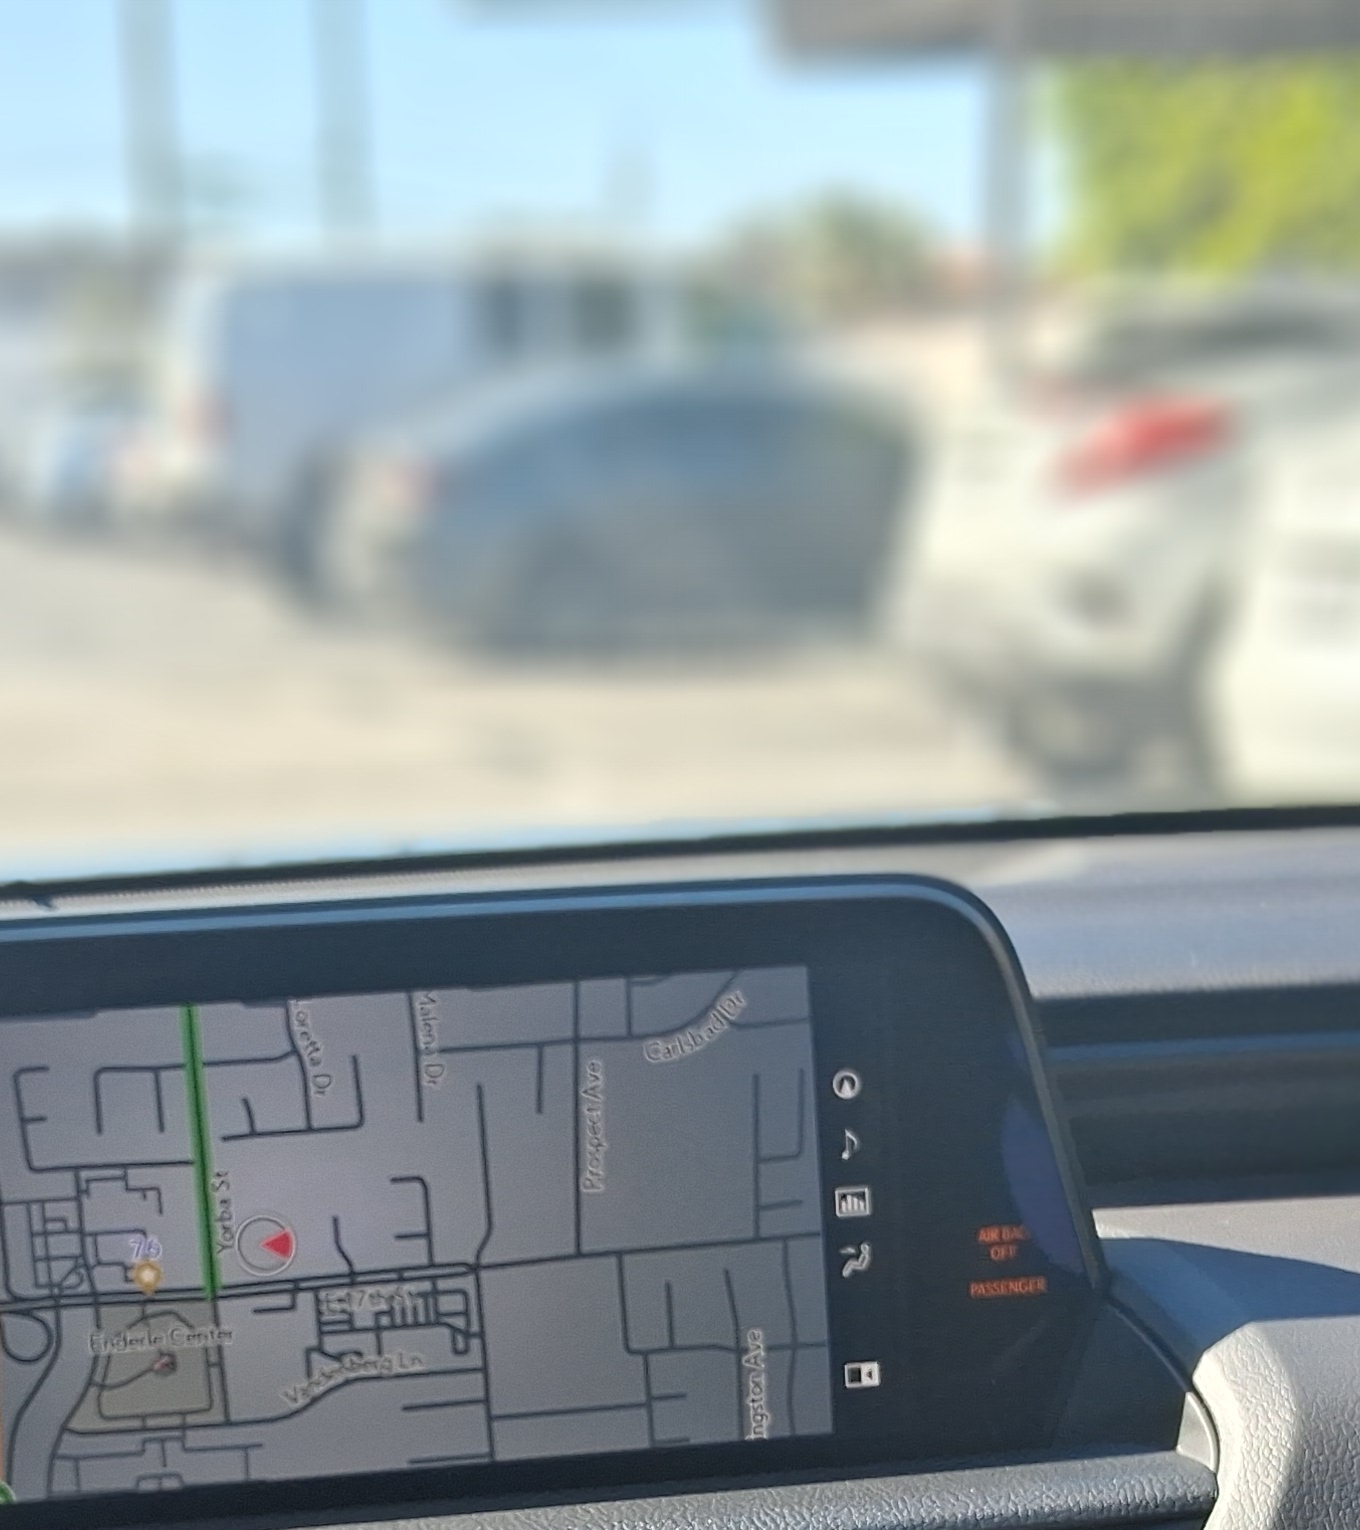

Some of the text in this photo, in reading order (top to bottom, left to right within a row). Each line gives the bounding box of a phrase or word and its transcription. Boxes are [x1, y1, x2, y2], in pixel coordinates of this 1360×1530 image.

[645, 992, 745, 1062] Carlsbad Dr
[313, 1073, 332, 1096] Dr
[424, 1063, 445, 1085] Dr
[582, 1061, 605, 1191] Prospect Ave
[211, 1171, 233, 1254] Yorba St
[970, 1276, 1046, 1298] PASSENGER
[743, 1330, 769, 1439] ngston Ave
